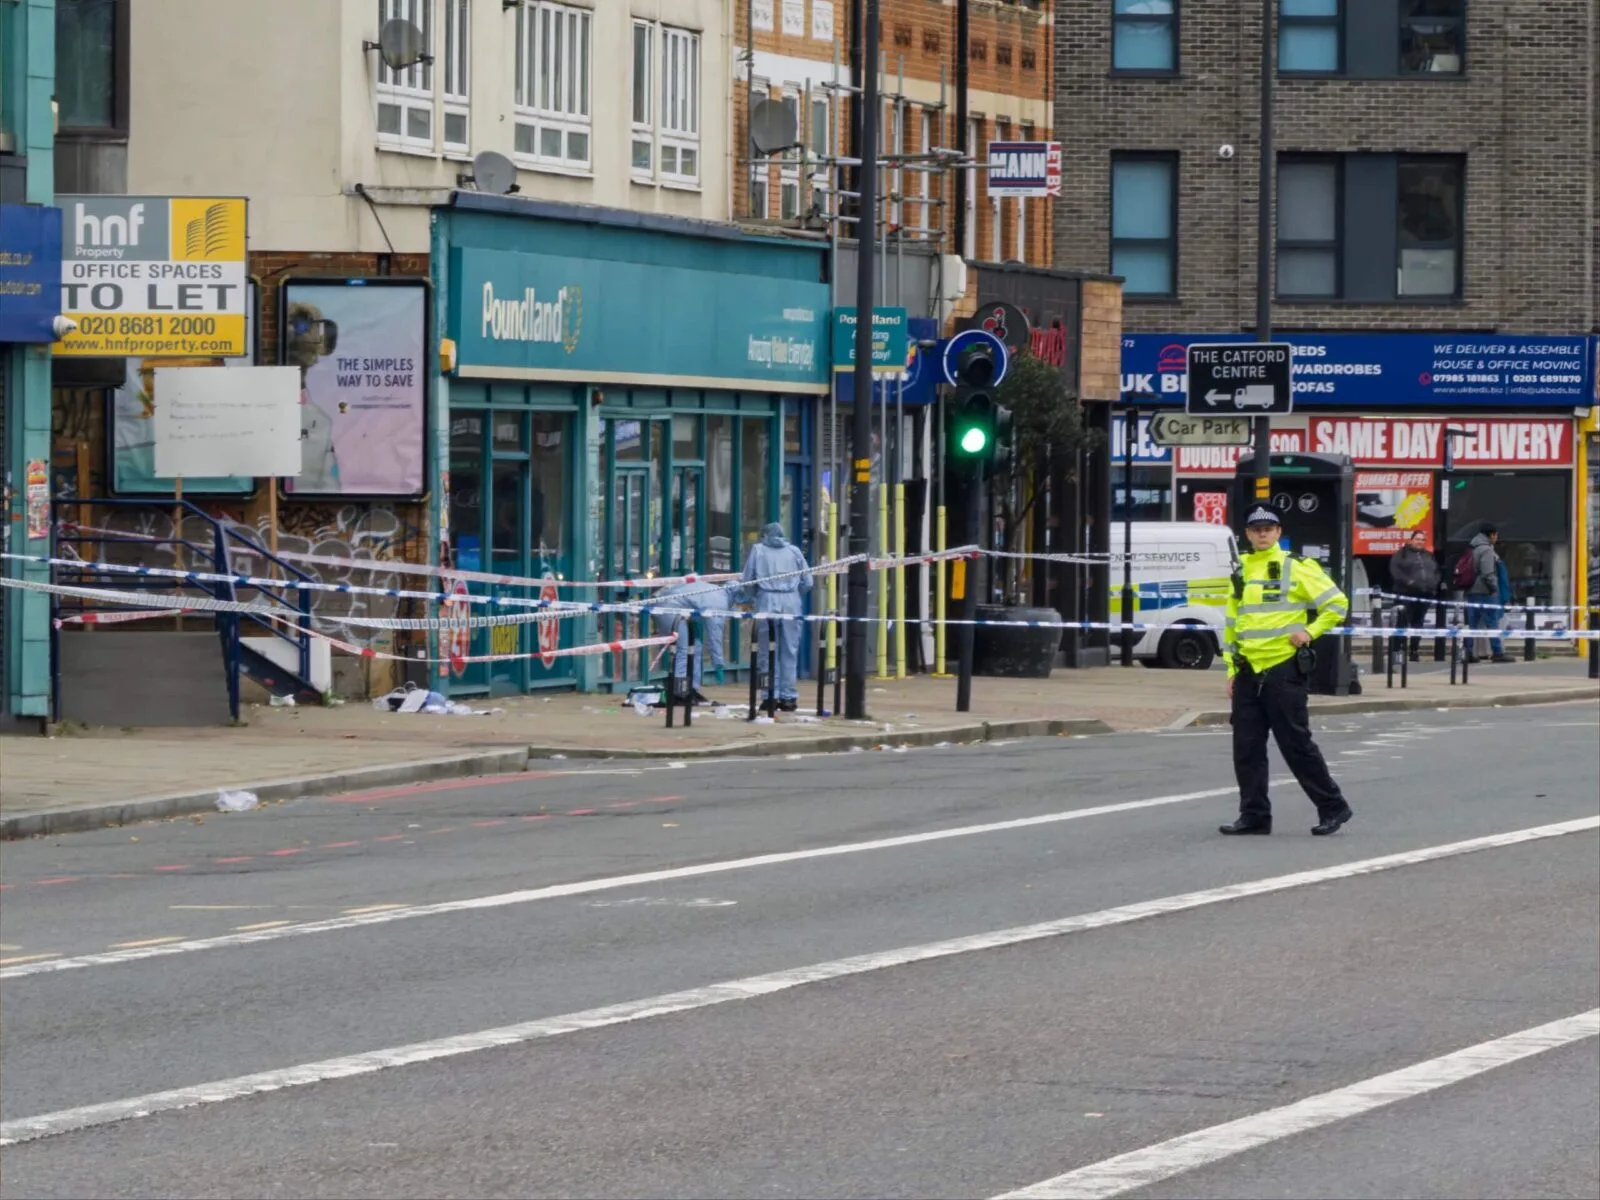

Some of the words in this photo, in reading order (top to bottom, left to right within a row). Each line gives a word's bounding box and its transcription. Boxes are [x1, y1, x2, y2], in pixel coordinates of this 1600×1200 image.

[991, 153, 1046, 178] MANN
[75, 203, 144, 246] hnf
[75, 246, 124, 259] Property
[73, 263, 140, 278] OFFICE
[148, 264, 222, 279] SPACES
[61, 283, 123, 310] TO
[147, 284, 237, 310] LET
[482, 281, 564, 343] Poundland
[80, 317, 116, 335] 020
[119, 317, 164, 335] 8681
[169, 317, 215, 335] 2000
[64, 338, 232, 353] www.hnfproperty.com
[1291, 346, 1326, 356] BEDS
[1433, 345, 1453, 354] WE
[1455, 345, 1506, 354] DELIVER
[1508, 345, 1515, 354] &
[1518, 345, 1580, 355] ASSEMBLE
[1192, 351, 1219, 363] THE
[1223, 350, 1285, 362] CATFORD
[337, 358, 360, 371] THE
[363, 358, 414, 371] SIMPLES
[1212, 365, 1267, 378] CENTRE
[1291, 364, 1382, 375] WARDROBES
[1432, 360, 1474, 370] HOUSE
[1477, 360, 1484, 370] &
[1488, 360, 1529, 370] OFFICE
[1532, 360, 1580, 370] MOVING
[336, 374, 362, 387] WAY
[366, 374, 381, 387] TO
[384, 374, 414, 387] SAVE
[1120, 374, 1154, 392] UK
[1291, 382, 1335, 393] SOFAS
[1167, 420, 1197, 435] Car
[1203, 419, 1240, 435] Park
[1316, 421, 1387, 458] SAME
[1393, 422, 1441, 459] DAY
[1447, 423, 1563, 459] DELIVERY
[1194, 493, 1227, 507] OPEN
